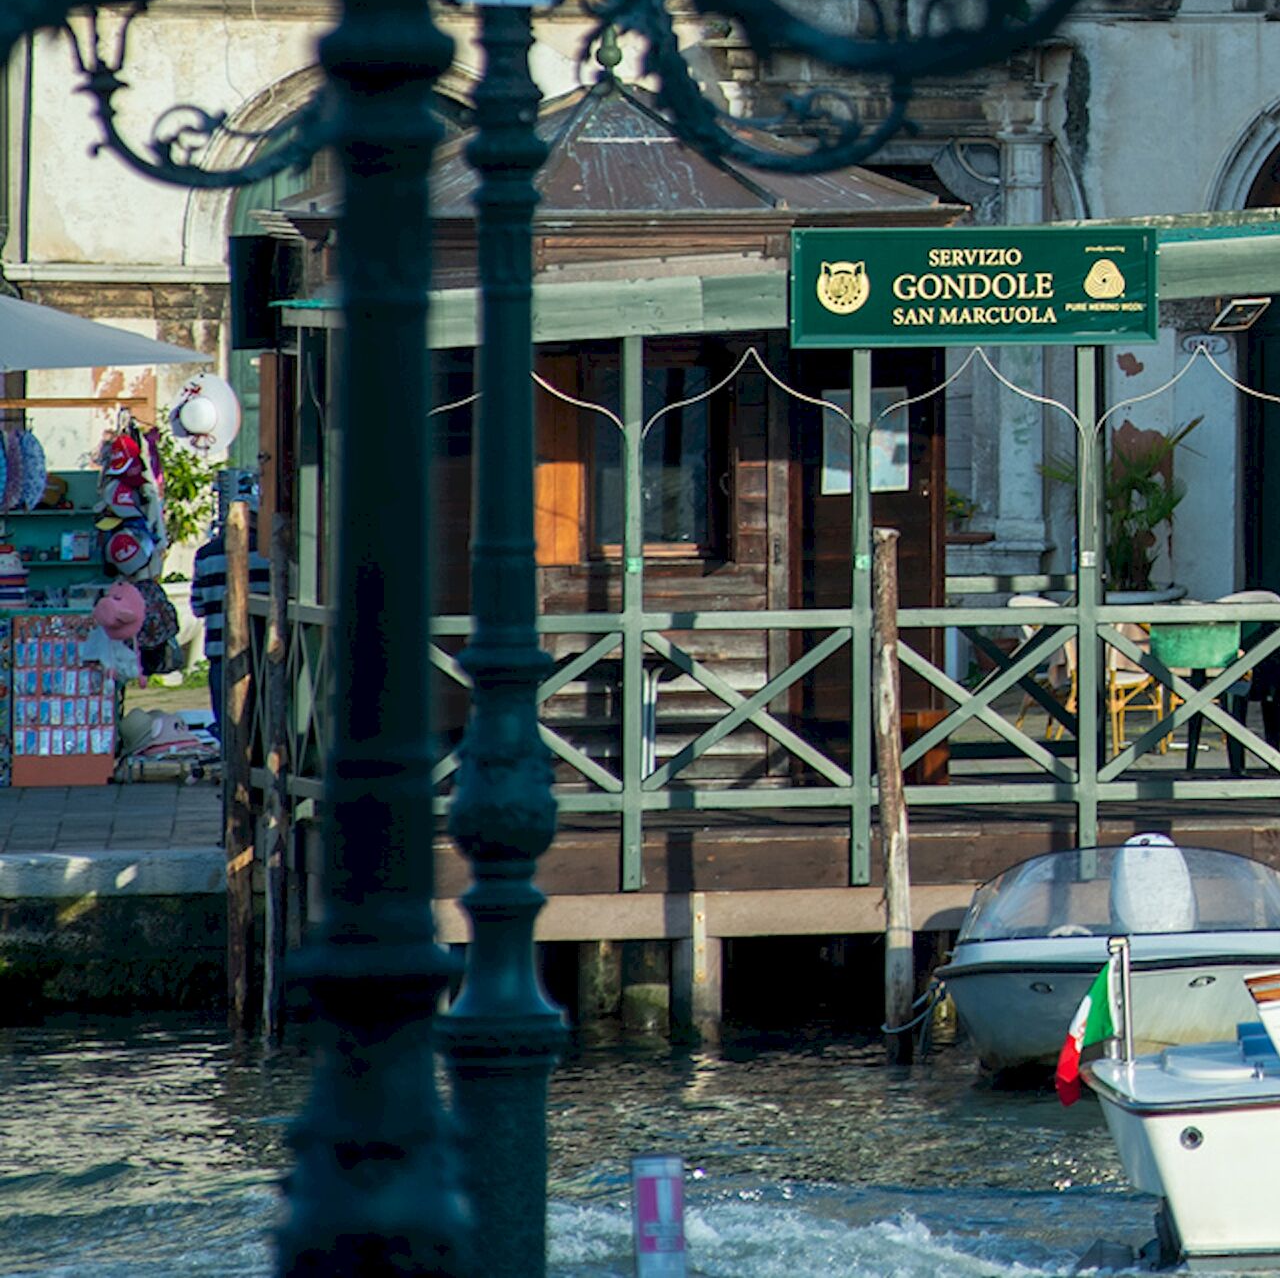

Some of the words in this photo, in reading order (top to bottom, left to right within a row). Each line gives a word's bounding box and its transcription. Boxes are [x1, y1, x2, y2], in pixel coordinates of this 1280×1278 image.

[928, 248, 1023, 267] SERVIZIO
[892, 272, 1055, 300] GONDOLE
[892, 307, 935, 325] SAN
[939, 305, 1057, 325] MARCUOLA
